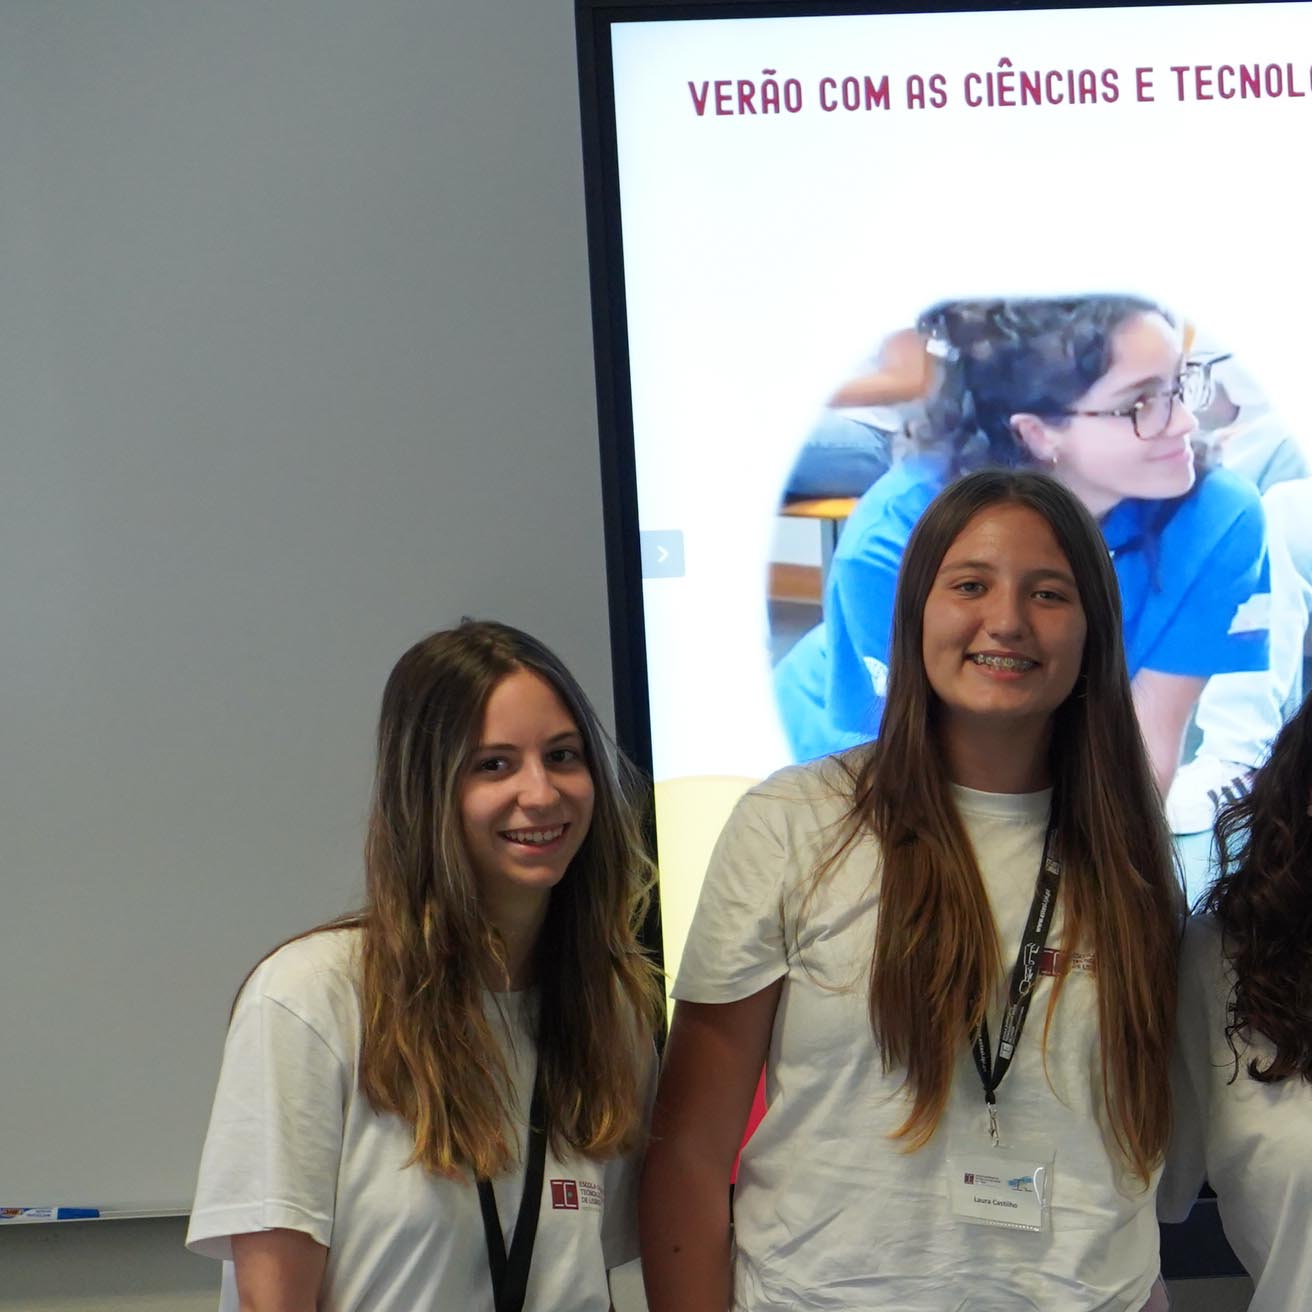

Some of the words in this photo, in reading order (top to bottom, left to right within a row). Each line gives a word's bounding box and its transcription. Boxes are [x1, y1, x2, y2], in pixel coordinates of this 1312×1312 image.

[689, 68, 803, 116] VERÃO
[819, 76, 890, 111] COM
[907, 75, 947, 109] AS
[963, 57, 1119, 107] CIÊNCIAS
[1136, 68, 1153, 102] E
